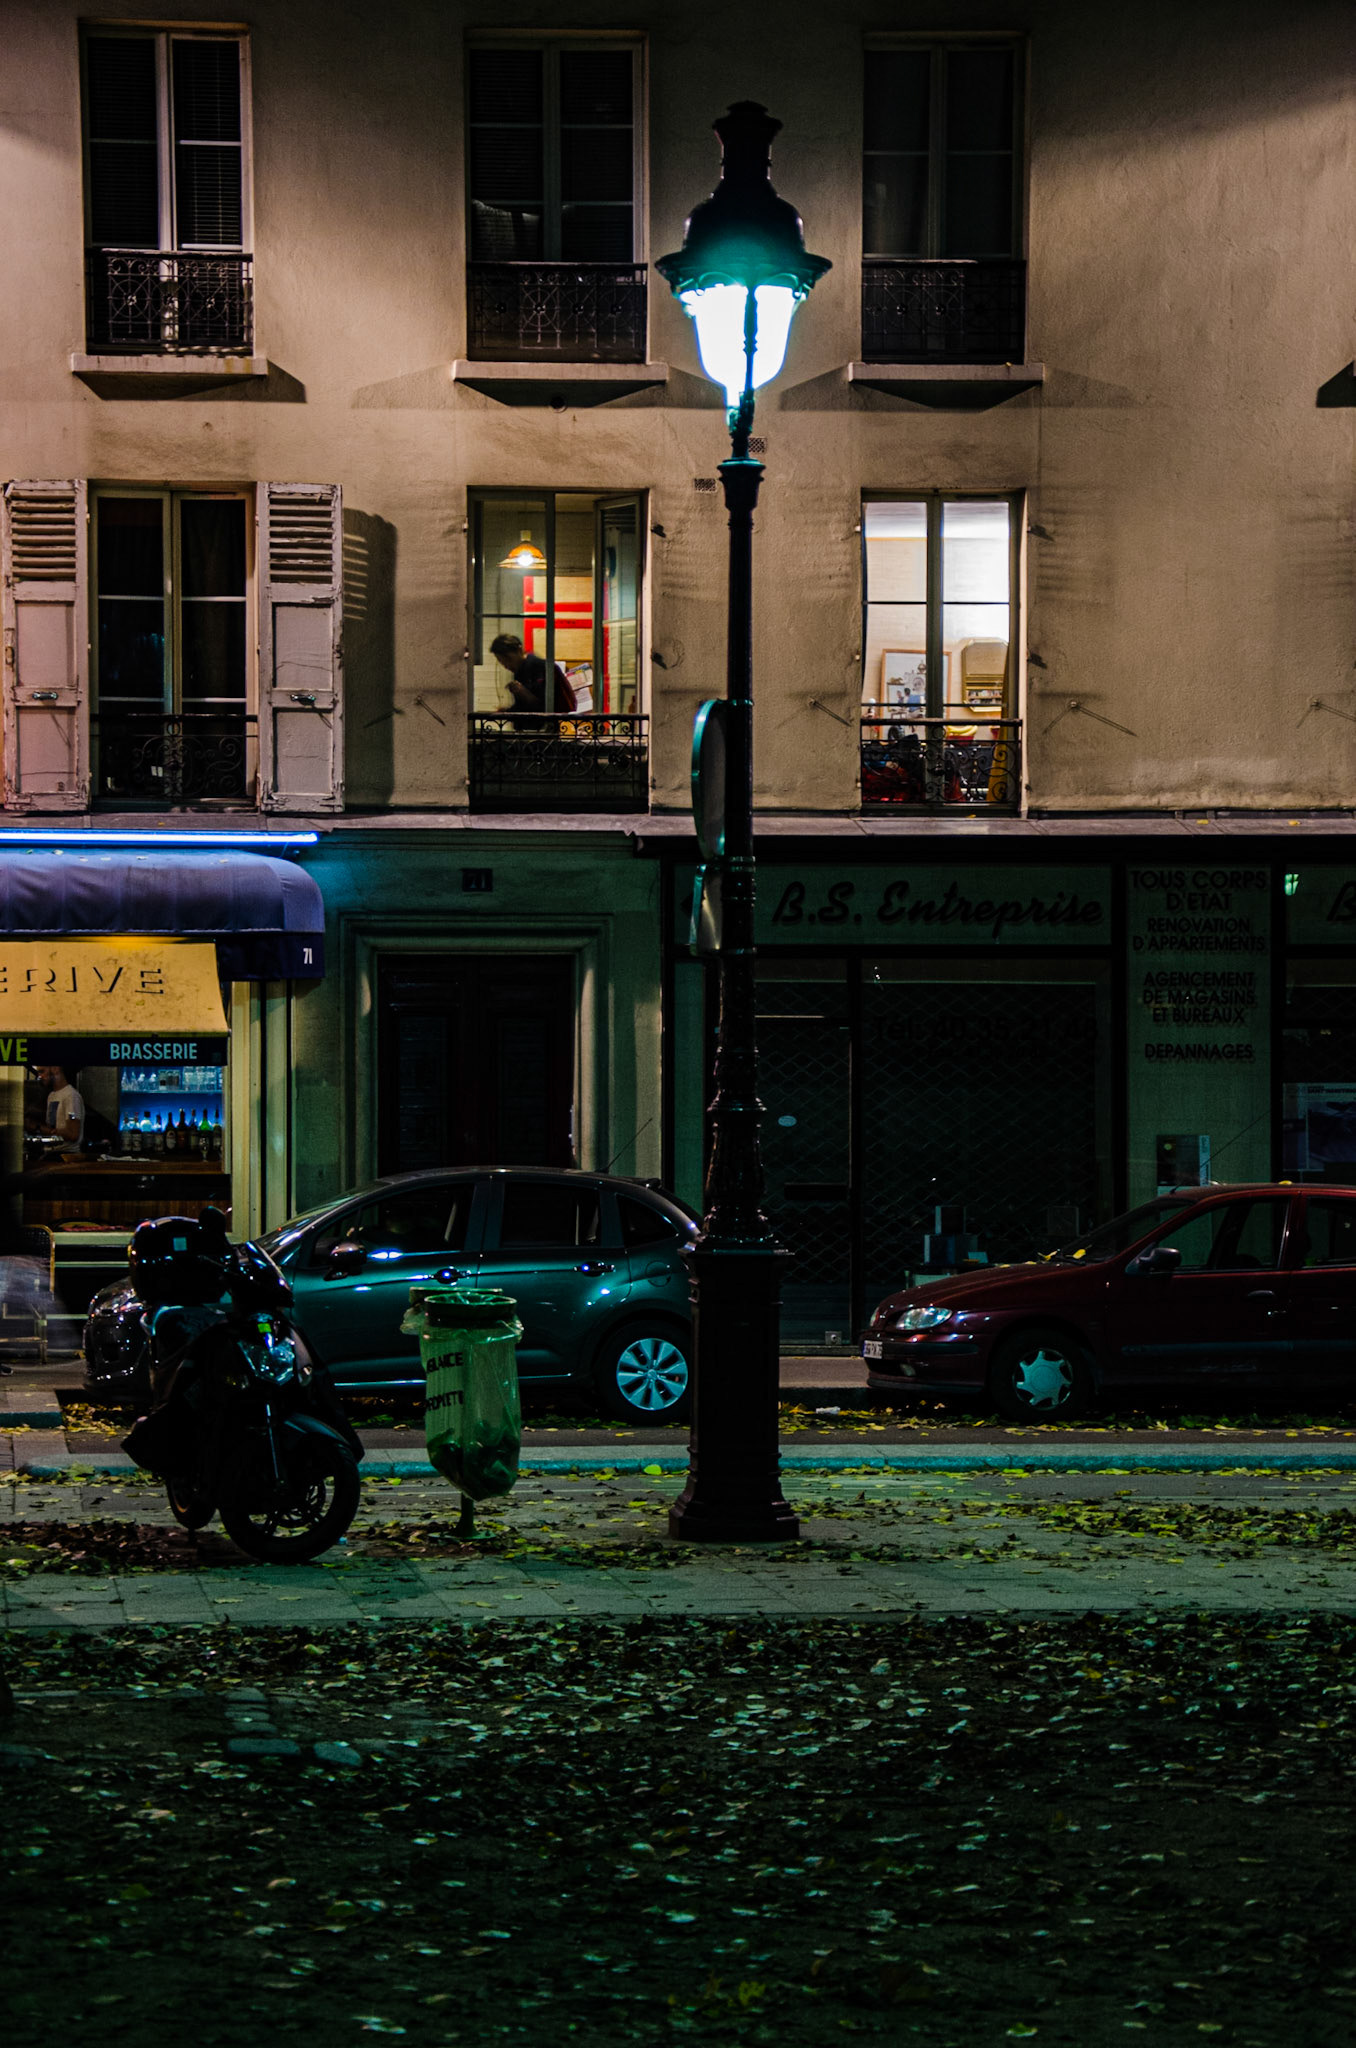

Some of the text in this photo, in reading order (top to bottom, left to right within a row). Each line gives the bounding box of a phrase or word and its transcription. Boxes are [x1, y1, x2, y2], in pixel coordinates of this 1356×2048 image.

[1130, 870, 1266, 889] TOUS CORPS
[1166, 892, 1232, 910] D'ETAT
[772, 880, 1103, 940] B.S. Entreprise
[1147, 917, 1250, 933] RENOVATION
[1132, 935, 1266, 951] D'APPARTEMENTS
[302, 947, 314, 965] 71
[1143, 971, 1255, 987] AGENCEMENT
[1143, 989, 1256, 1005] DE MAGASINS
[1153, 1007, 1246, 1023] ET BUREAUX
[0, 1038, 28, 1062] VE
[109, 1042, 198, 1061] BRASSERIE
[1144, 1043, 1253, 1059] DEPANNAGES
